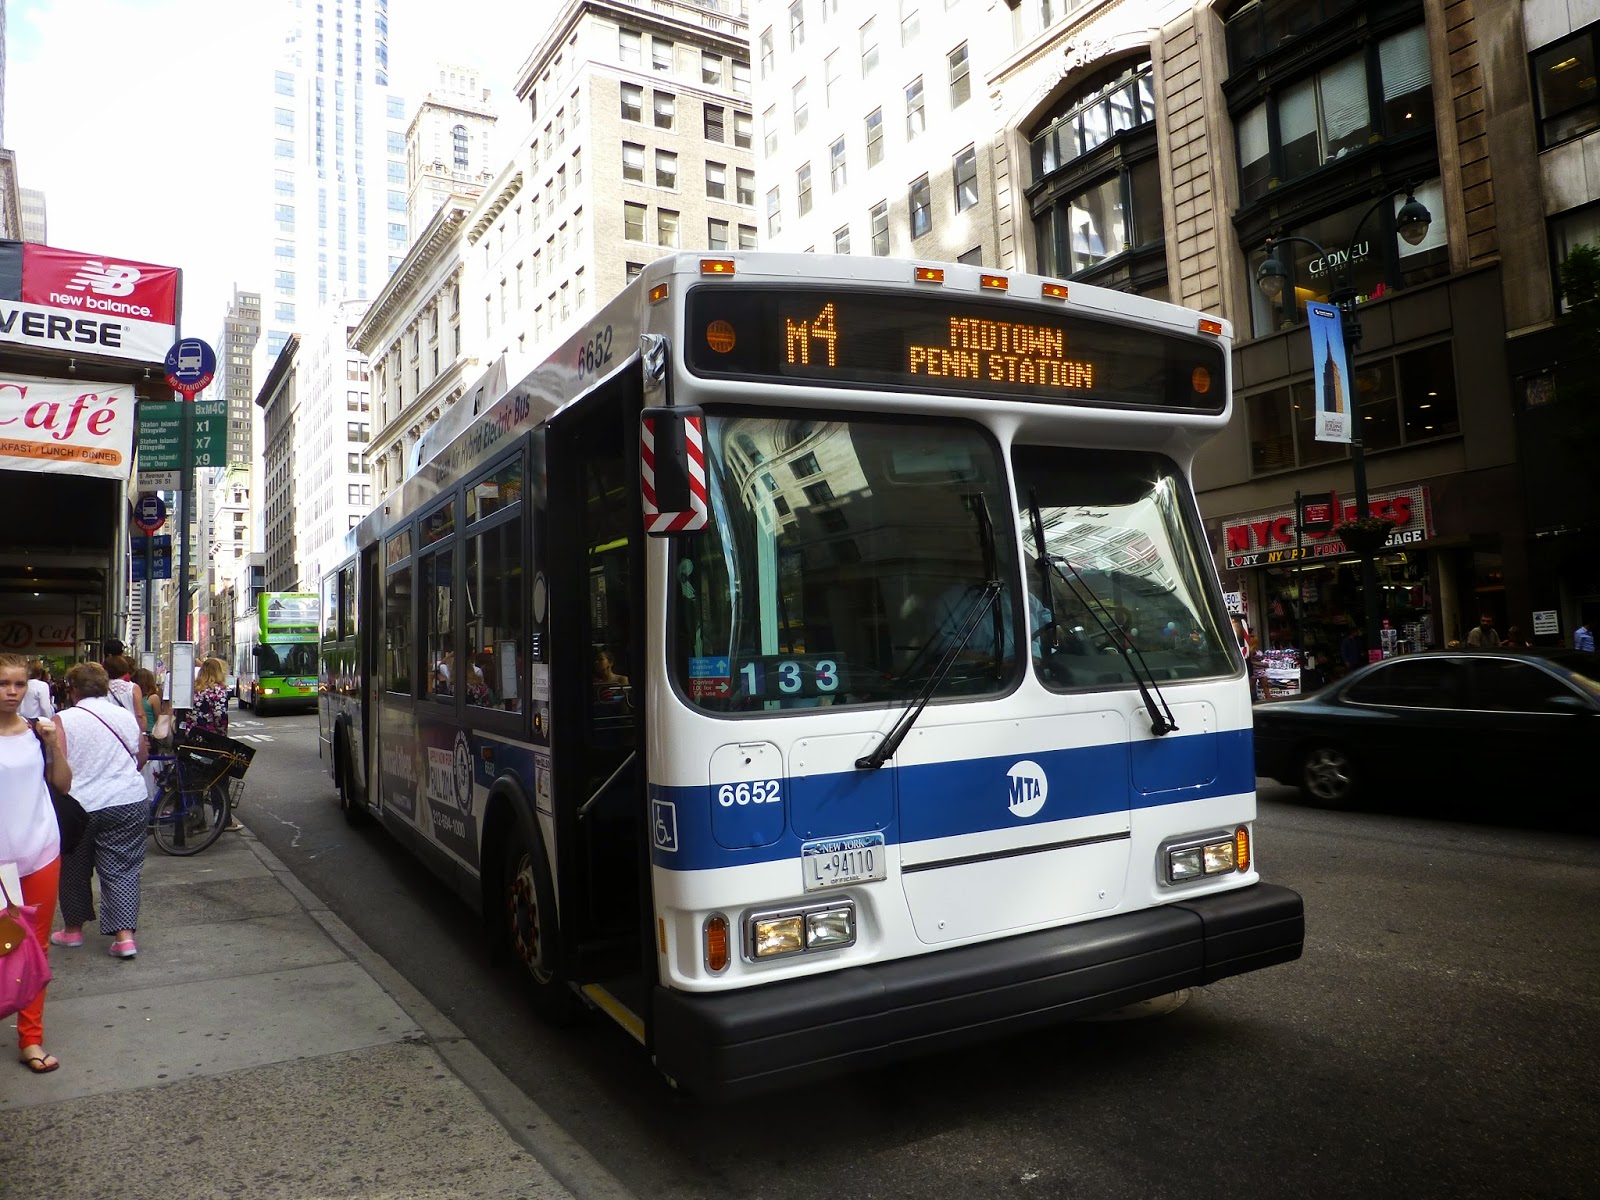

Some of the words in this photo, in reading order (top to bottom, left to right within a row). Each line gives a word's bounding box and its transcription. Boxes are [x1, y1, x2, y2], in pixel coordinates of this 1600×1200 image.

[1308, 241, 1369, 273] CEDIVEU
[1310, 256, 1369, 279] PROSSINAL
[50, 292, 83, 306] new
[785, 301, 838, 367] M4
[950, 316, 1063, 358] MIDTOWN
[577, 325, 613, 381] 6652
[910, 346, 979, 379] PENN
[988, 354, 1092, 389] STATION
[168, 376, 178, 386] NO
[177, 375, 210, 391] STANDING
[0, 384, 119, 440] Café
[195, 402, 225, 415] BxM4C
[196, 420, 210, 432] x1
[461, 425, 482, 468] Hybrid
[483, 404, 512, 449] Electric
[513, 393, 530, 426] Bus
[196, 437, 211, 449] x7
[1, 443, 33, 453] KFAST
[41, 447, 74, 456] LUNCH
[82, 451, 117, 461] DINNER
[195, 453, 211, 466] x9
[153, 537, 163, 545] M1
[1227, 517, 1293, 551] NYC
[153, 549, 163, 557] M2
[1313, 541, 1347, 556] FDNY
[153, 559, 164, 567] M3
[153, 569, 164, 578] M5
[718, 780, 781, 807] 6652
[1006, 775, 1041, 807] MTA
[822, 842, 841, 853] NEW
[844, 839, 865, 850] YORK
[830, 875, 861, 884] OFFICIAL
